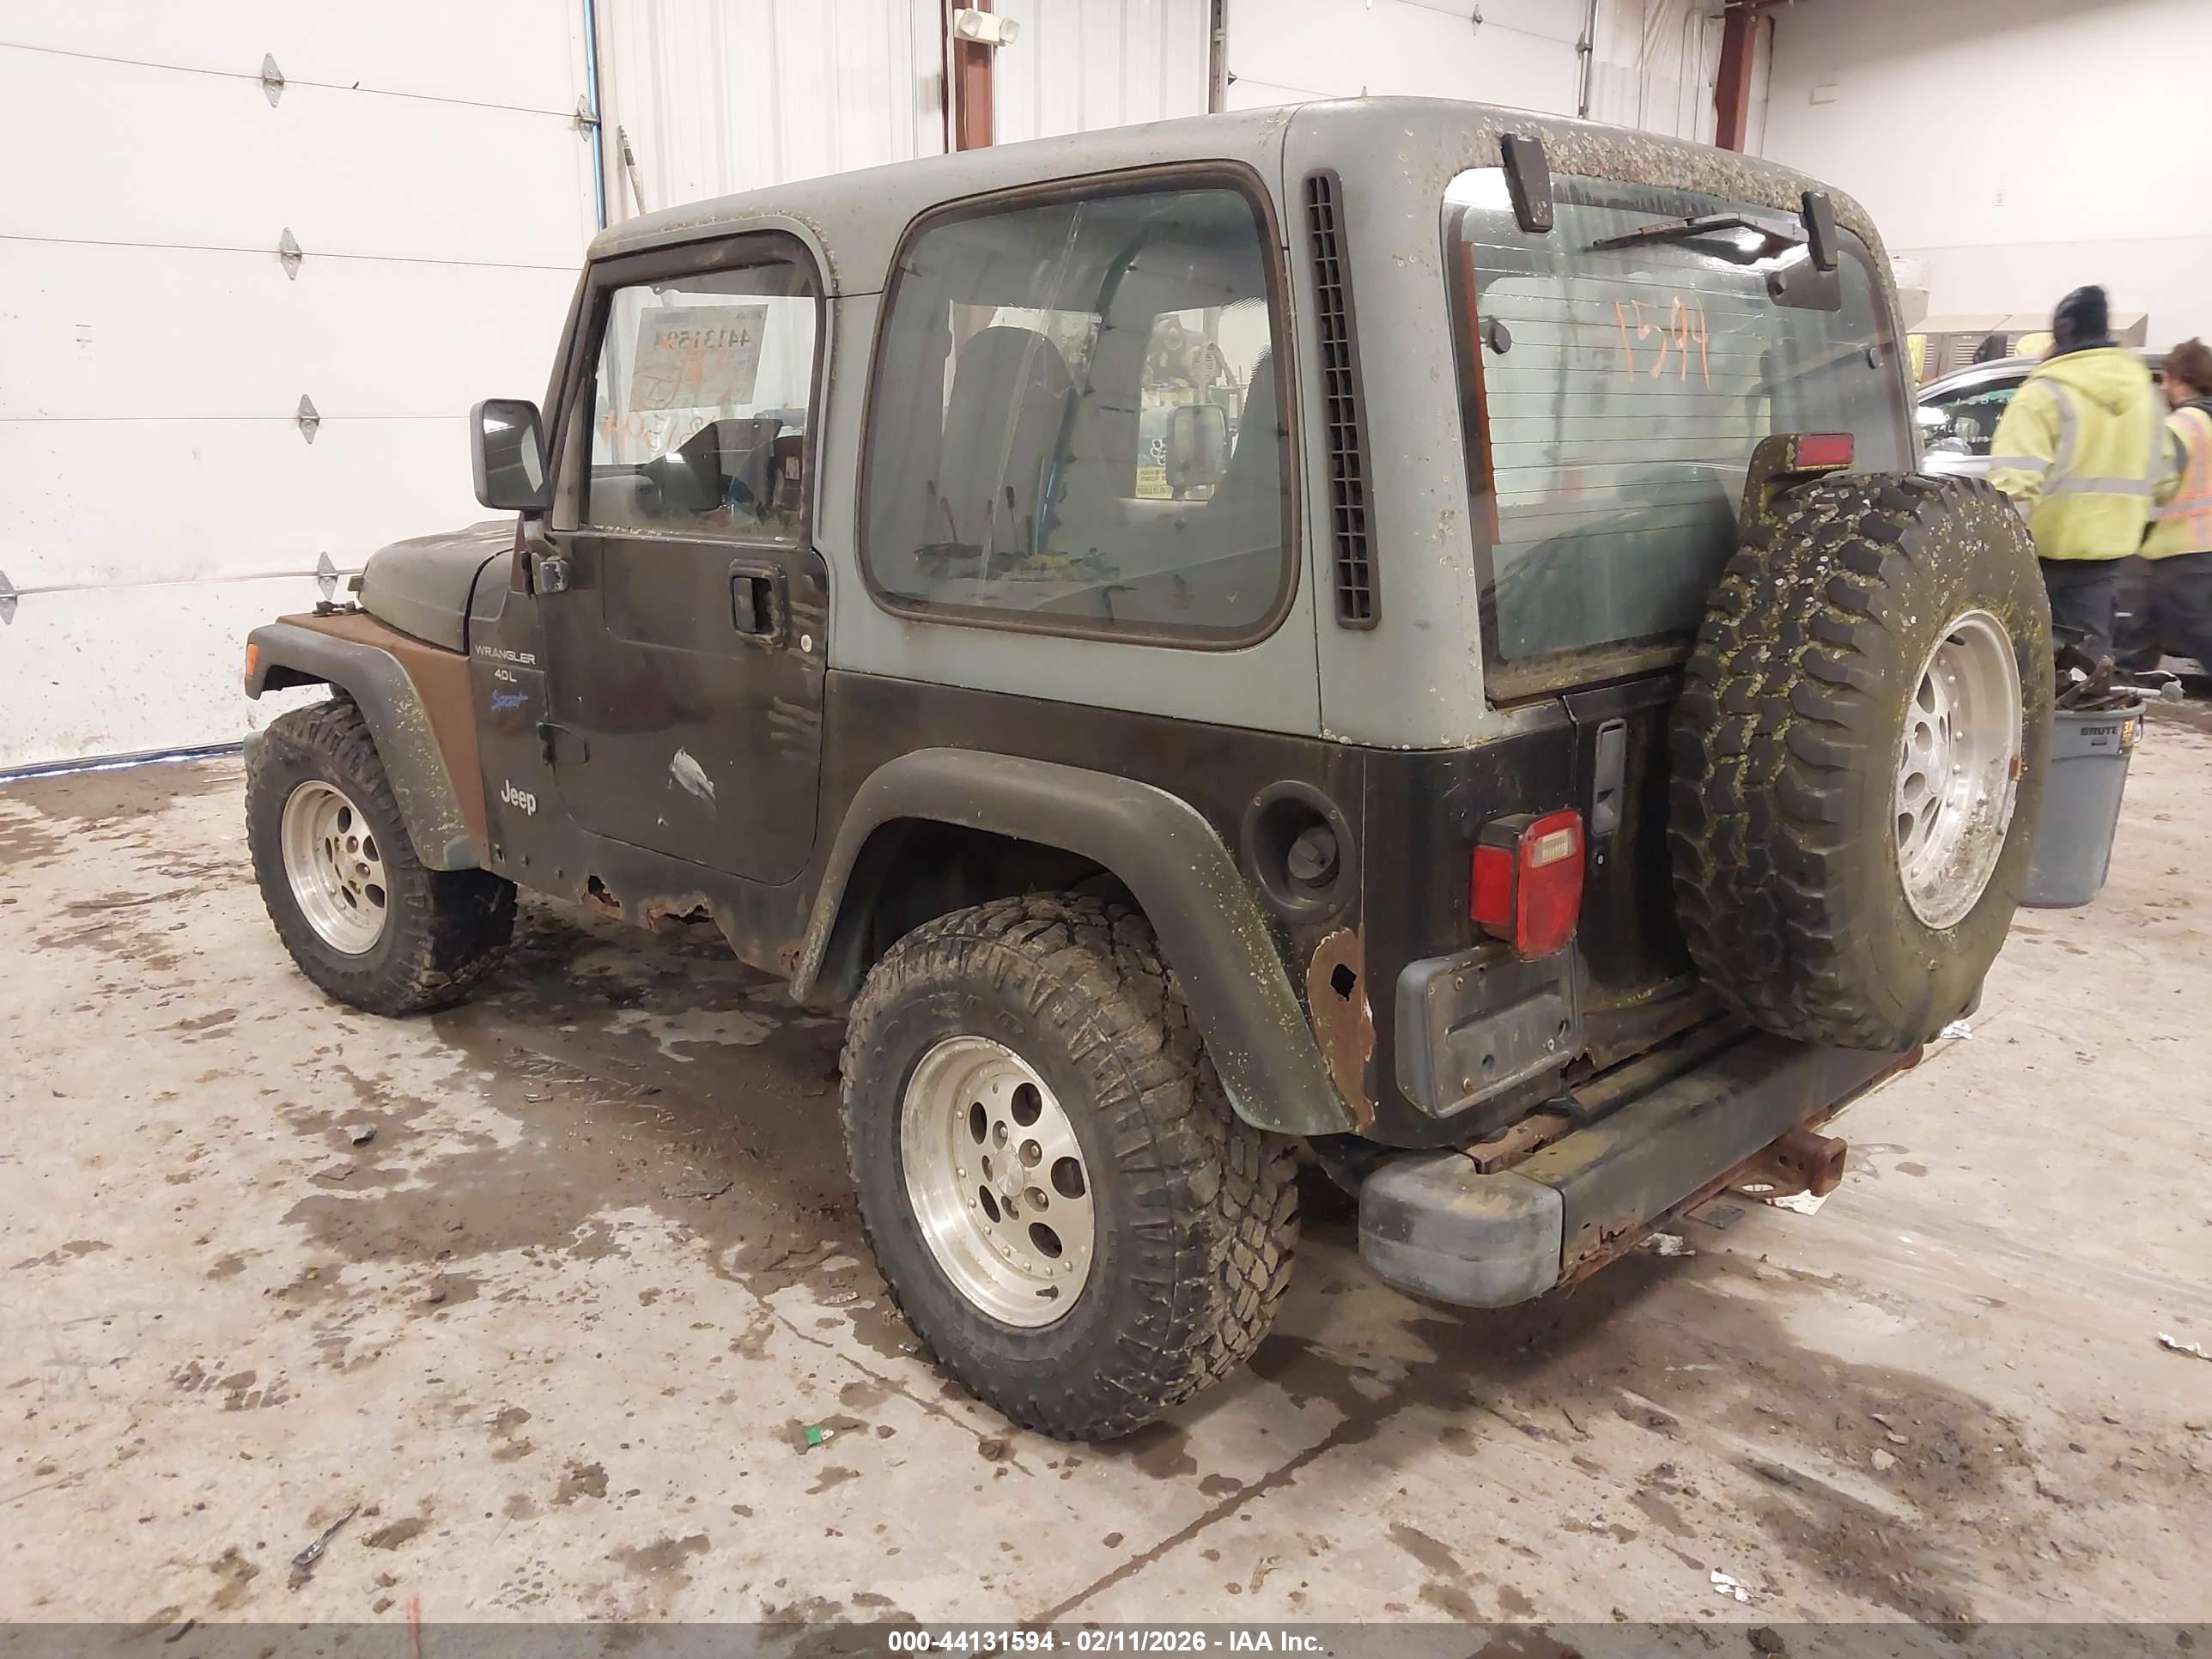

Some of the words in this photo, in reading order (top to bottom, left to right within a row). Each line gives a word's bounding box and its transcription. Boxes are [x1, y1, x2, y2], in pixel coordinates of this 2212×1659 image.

[474, 644, 537, 665] WRANGLER
[2081, 726, 2118, 737] BRUTE
[501, 779, 538, 817] Jeep
